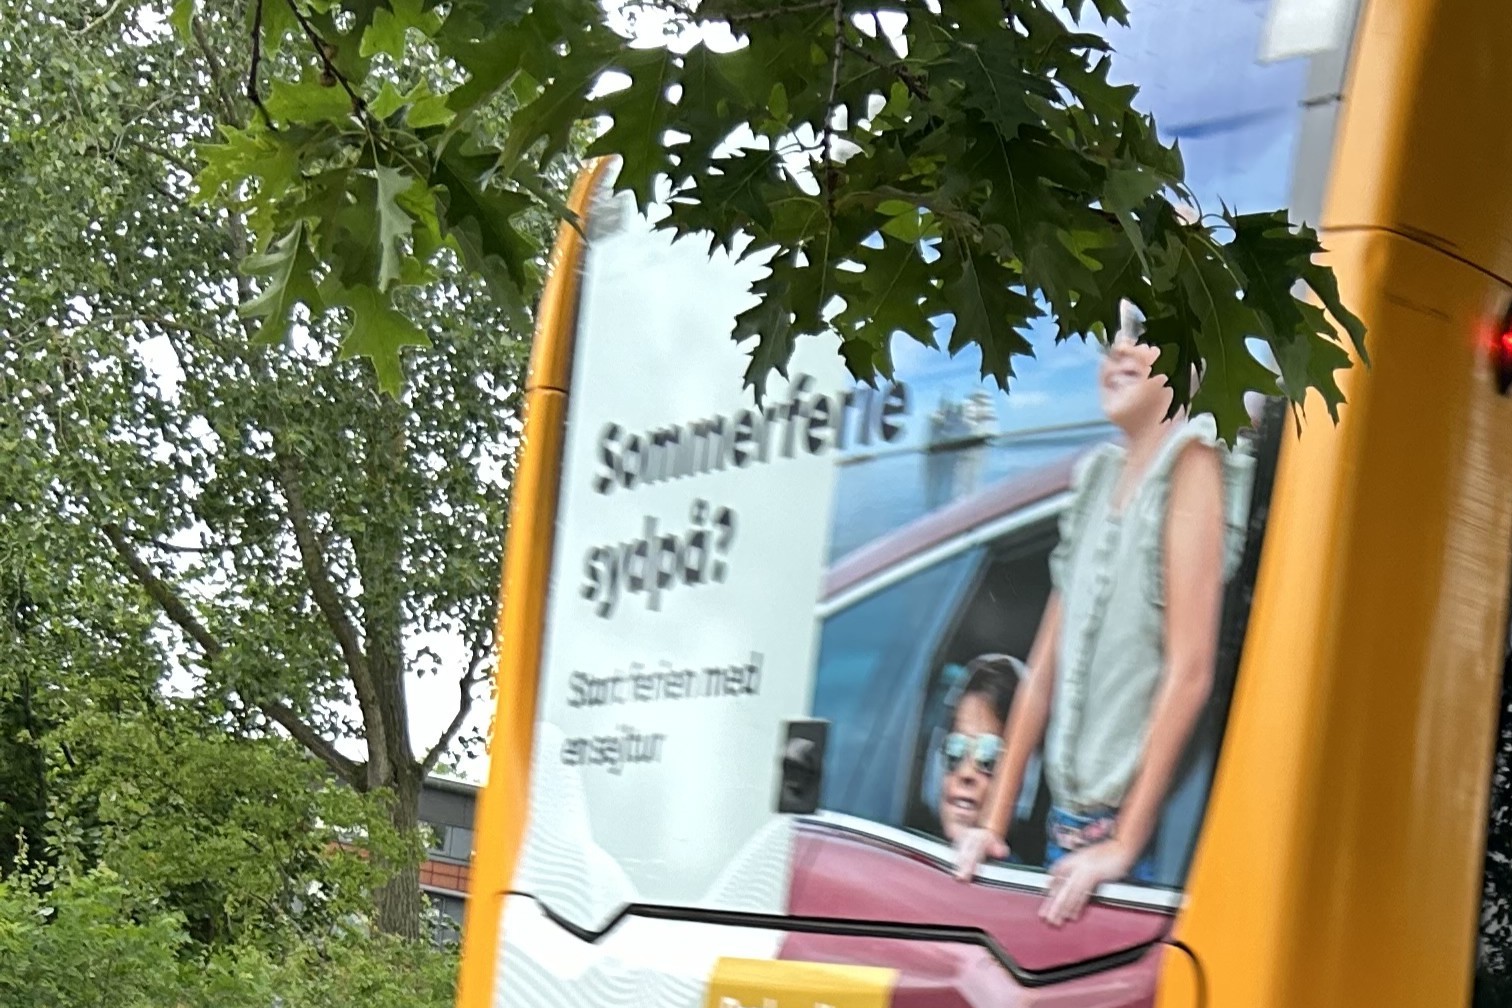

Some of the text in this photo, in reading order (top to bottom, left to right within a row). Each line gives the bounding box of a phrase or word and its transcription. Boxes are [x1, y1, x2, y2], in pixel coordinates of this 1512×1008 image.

[592, 371, 910, 495] Sommerferie
[580, 498, 738, 619] sydpå?
[701, 651, 765, 701] med
